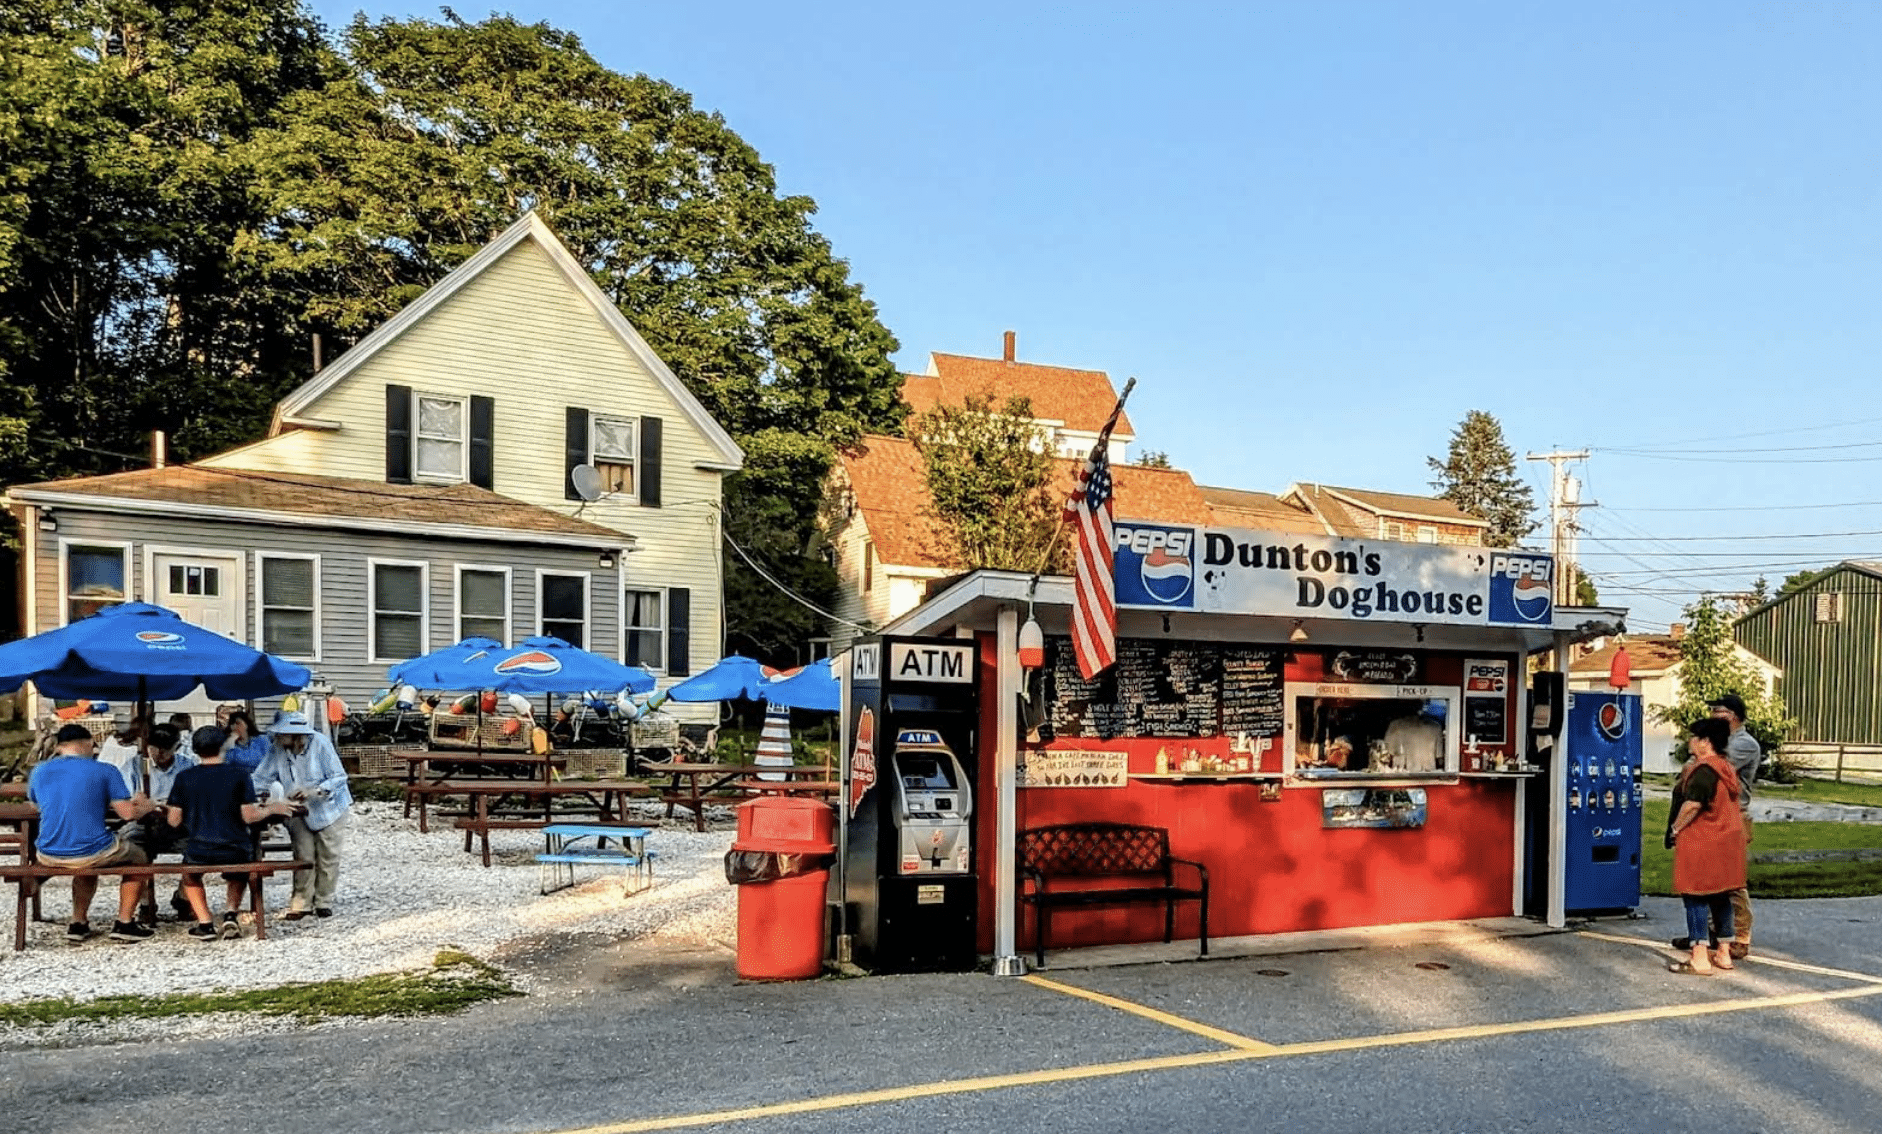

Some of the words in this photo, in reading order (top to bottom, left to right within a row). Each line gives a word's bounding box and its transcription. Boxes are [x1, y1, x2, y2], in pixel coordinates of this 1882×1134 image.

[1113, 528, 1192, 559] PEPSI
[1202, 532, 1382, 575] Dunton's
[1491, 556, 1552, 581] PEPSI
[1295, 576, 1483, 618] Doghouse
[856, 644, 877, 677] ATM
[900, 649, 963, 678] ATM
[1470, 665, 1505, 678] PEPSI
[907, 733, 932, 743] ATM
